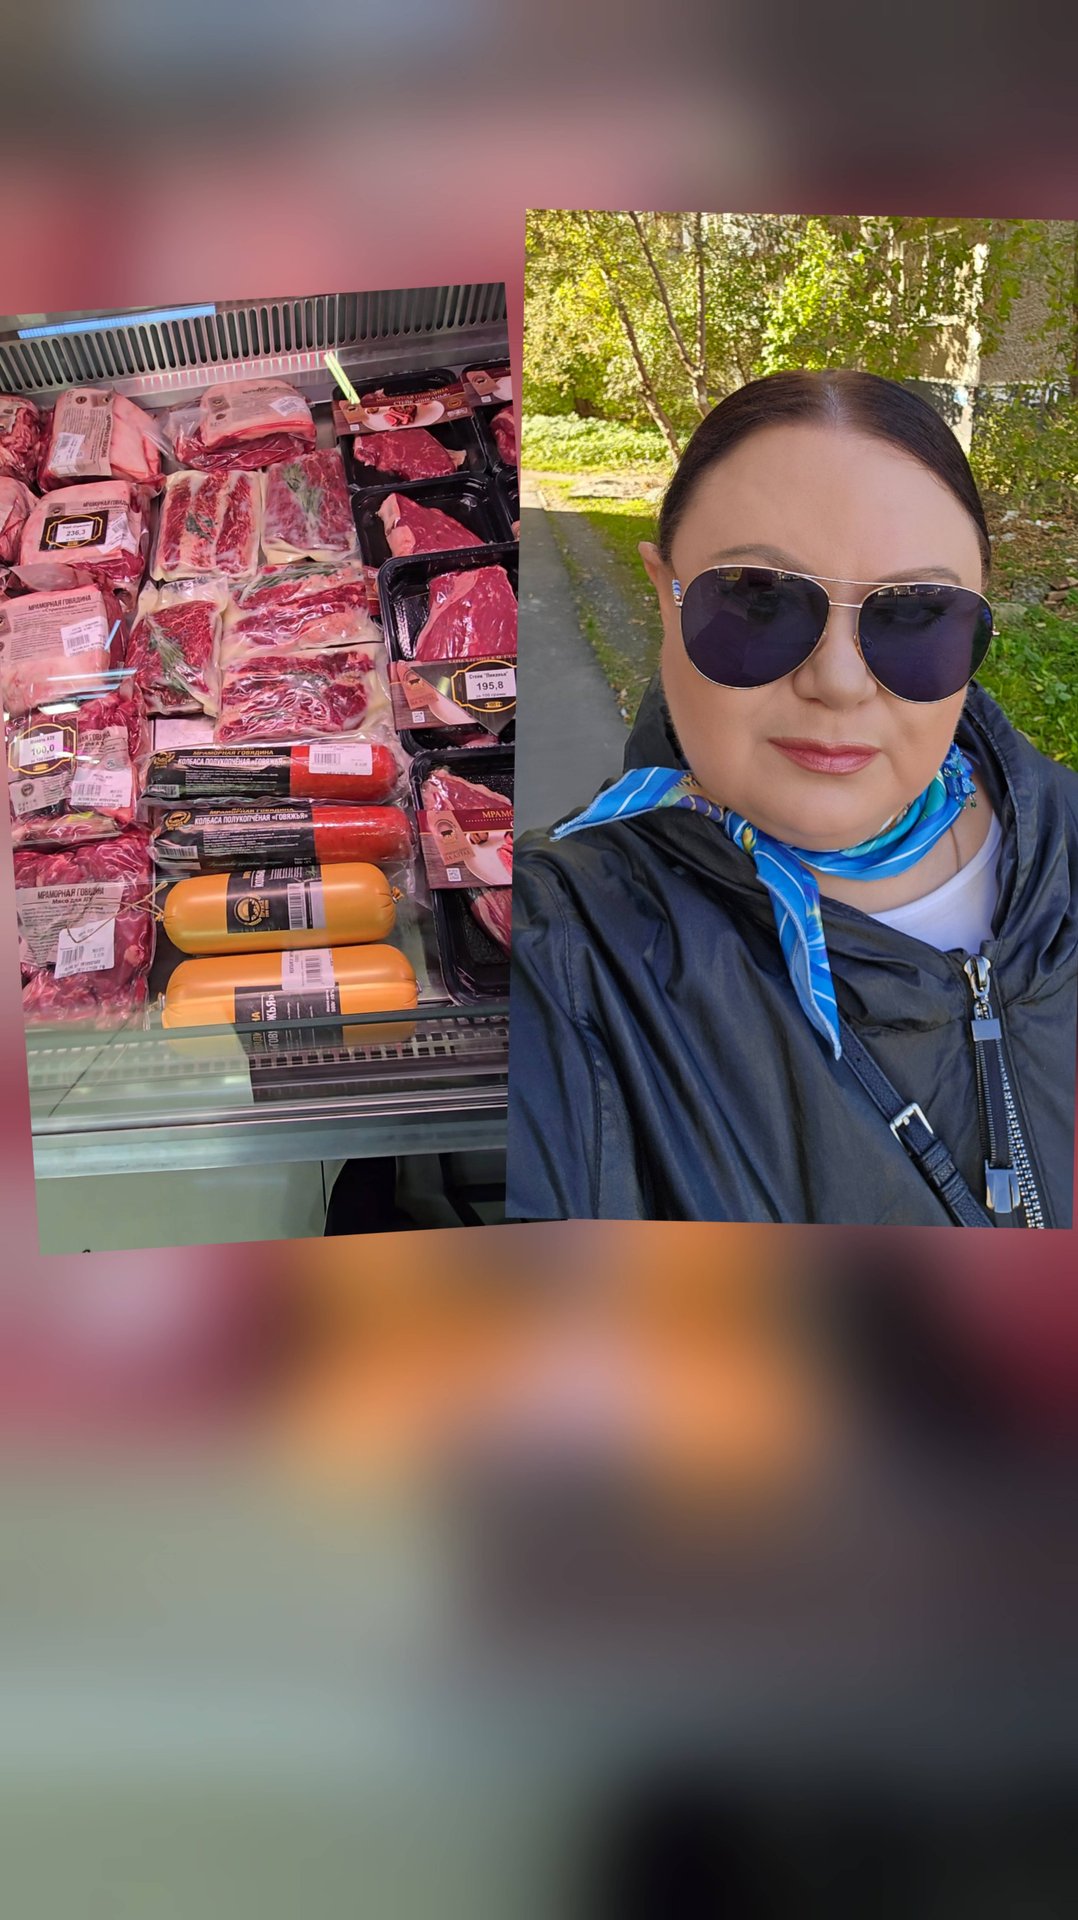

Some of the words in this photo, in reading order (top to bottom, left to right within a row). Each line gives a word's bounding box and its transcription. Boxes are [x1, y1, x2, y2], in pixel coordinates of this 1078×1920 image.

[476, 681, 504, 691] 195,8
[32, 744, 55, 756] 100,0
[177, 757, 205, 765] КОЛБАСА
[194, 815, 222, 825] КОЛБАСА
[223, 814, 271, 824] ПОЛУКОПЧЁНАЯ
[271, 813, 309, 821] «ГОВЯЖЬЯ»
[37, 888, 75, 900] МРАМОРНАЯ
